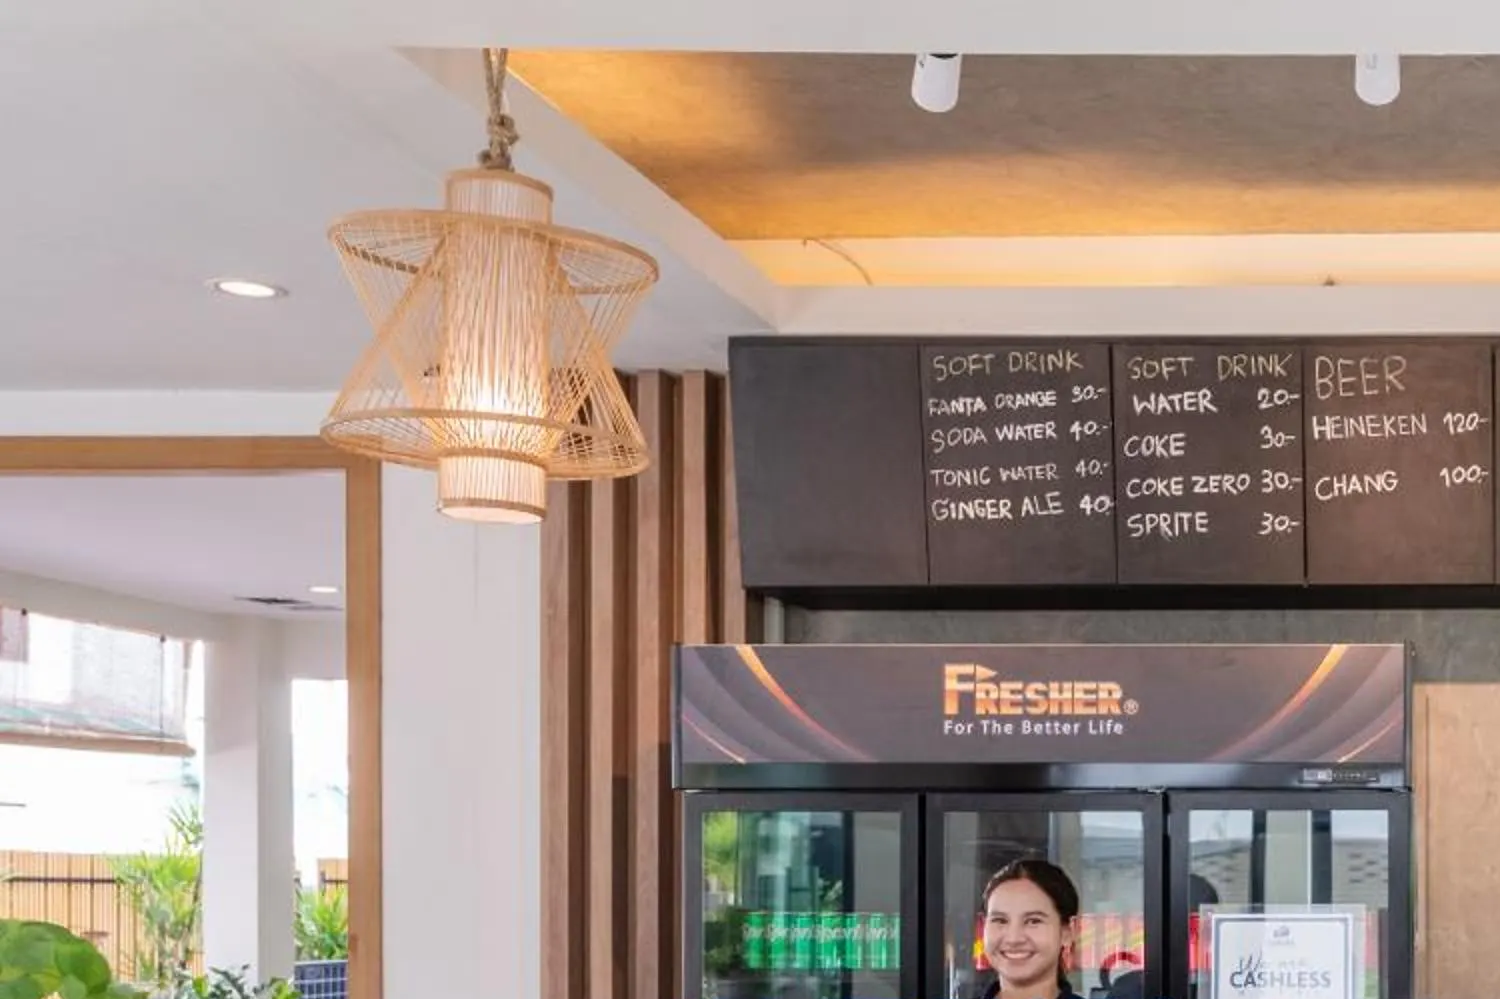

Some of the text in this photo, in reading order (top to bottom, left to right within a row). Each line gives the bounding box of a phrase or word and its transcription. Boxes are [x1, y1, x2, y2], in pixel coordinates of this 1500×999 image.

[933, 349, 1084, 382] SOFT DRINK
[1127, 353, 1293, 381] SOFT DRINK
[1315, 355, 1407, 400] BEER
[928, 397, 987, 417] FANTA
[995, 390, 1057, 410] ORANGE
[1132, 388, 1218, 416] WATER
[931, 427, 988, 454] SODA
[995, 421, 1057, 441] WATER
[1312, 413, 1427, 441] HEINEKEN
[1123, 432, 1186, 458] COKE
[930, 466, 991, 488] TONIC
[1000, 463, 1059, 482] WATER
[1126, 476, 1185, 499] COKE
[1191, 472, 1251, 496] ZERO
[1314, 469, 1400, 501] CHANG
[931, 497, 1013, 521] GINGER
[1020, 491, 1065, 518] ALE
[1127, 511, 1209, 540] SPRITE
[944, 719, 1124, 735] For The Better Life
[1229, 970, 1332, 989] CASHLESS
